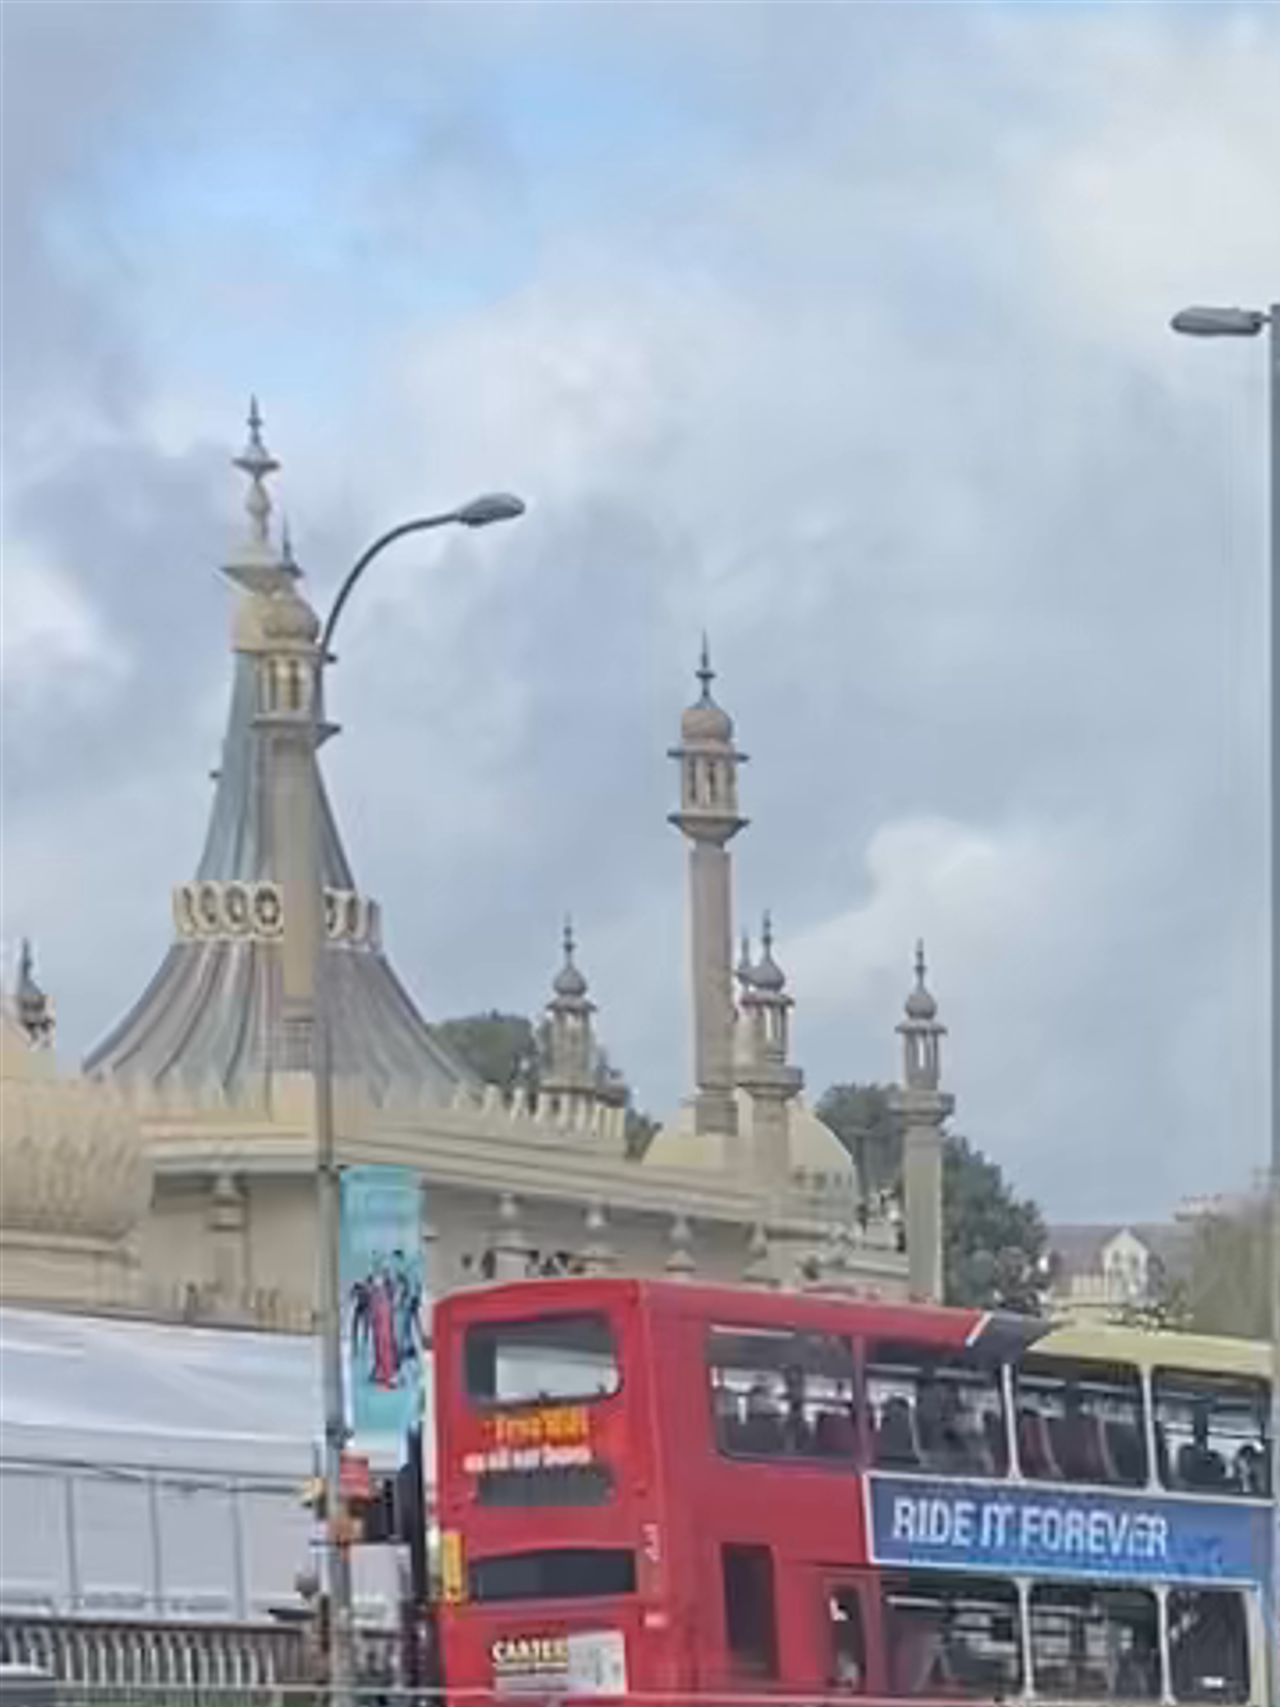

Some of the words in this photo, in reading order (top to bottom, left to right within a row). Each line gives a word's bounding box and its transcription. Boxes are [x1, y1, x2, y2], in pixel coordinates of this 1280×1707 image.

[892, 1496, 977, 1547] RIDE
[979, 1502, 1015, 1549] IT
[1020, 1506, 1168, 1557] FOREVER
